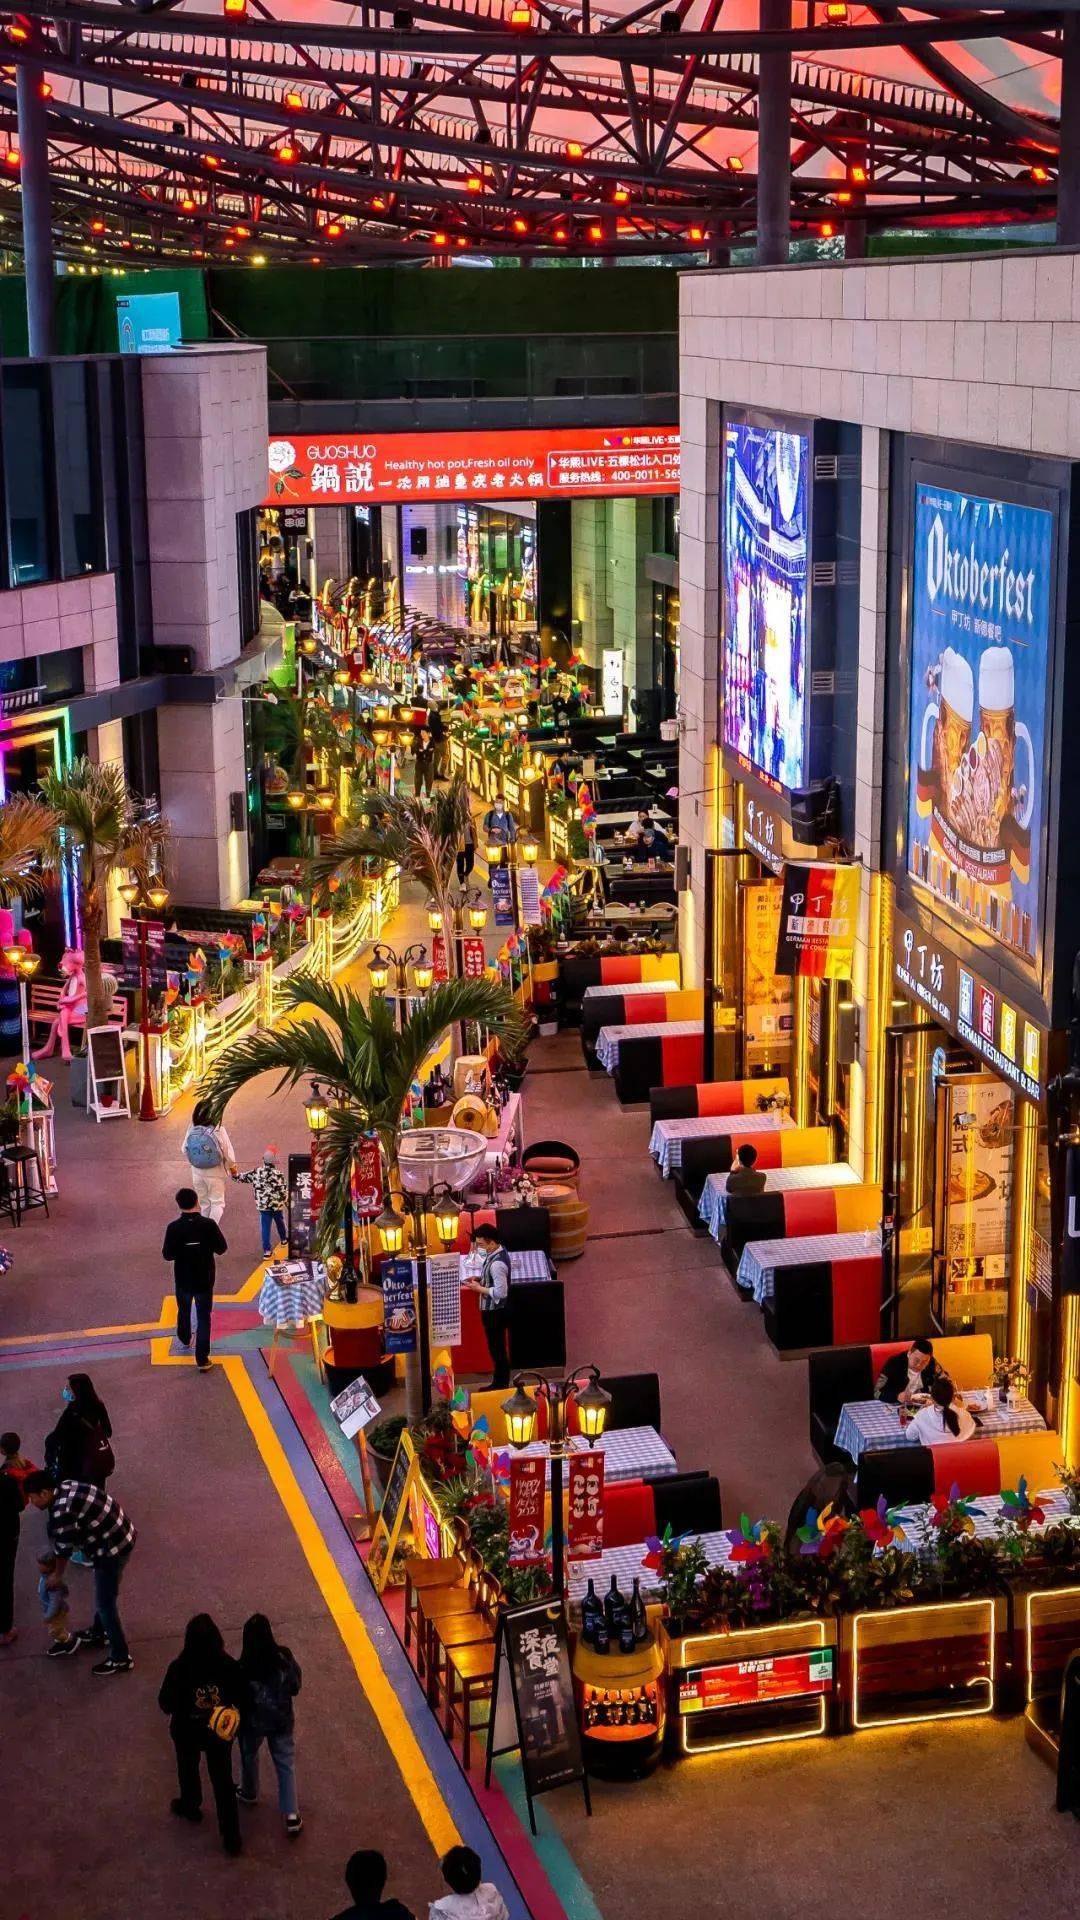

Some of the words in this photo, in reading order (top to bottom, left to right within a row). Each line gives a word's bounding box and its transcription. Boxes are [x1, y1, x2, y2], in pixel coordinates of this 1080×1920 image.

[306, 445, 376, 460] GUOSHUO
[385, 460, 425, 471] Healthy
[427, 460, 445, 469] hot
[498, 457, 510, 467] oil
[513, 457, 534, 468] only
[927, 513, 1036, 624] Oktoberfest
[957, 1018, 981, 1053] GERMAN
[982, 1043, 1021, 1084] RESTAURANT
[1026, 1078, 1041, 1101] BAR
[516, 1479, 541, 1490] HAPPY
[520, 1628, 560, 1656] 深夜
[526, 1651, 560, 1677] 食堂
